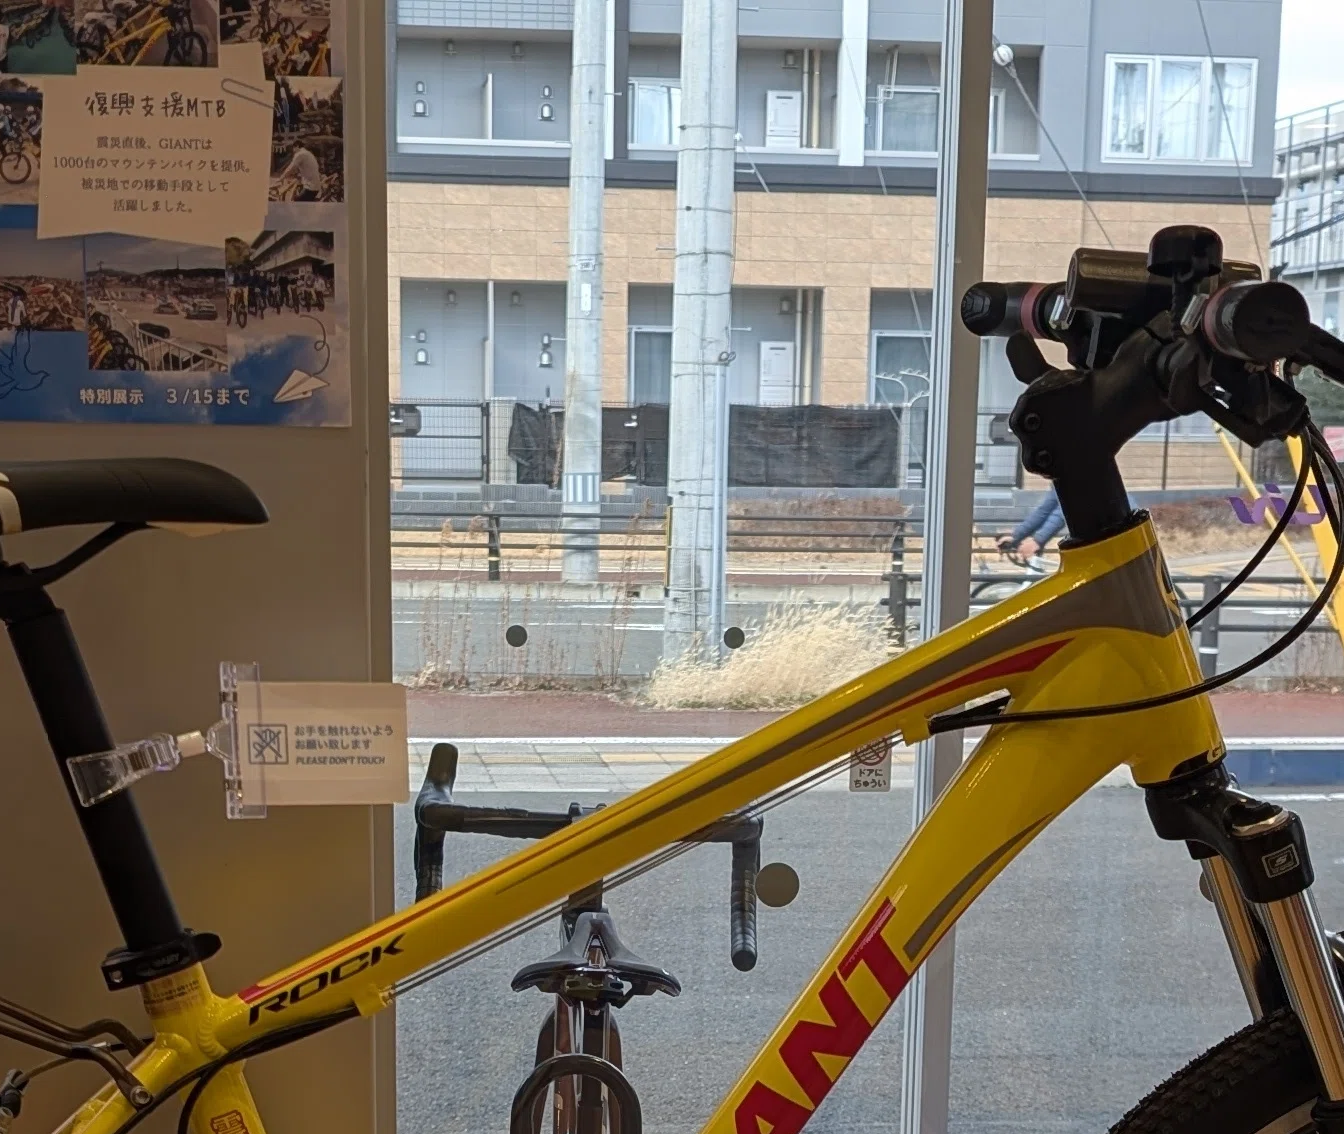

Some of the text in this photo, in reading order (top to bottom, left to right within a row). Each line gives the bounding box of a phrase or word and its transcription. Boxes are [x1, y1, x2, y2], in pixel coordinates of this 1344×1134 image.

[96, 135, 212, 151] 震災直後、GIANTは
[81, 177, 230, 193] 被災地での移動手段として
[112, 199, 194, 214] 活躍しました。
[79, 388, 145, 405] 特別展示
[296, 756, 386, 765] PLEASE DON'T TOUCH
[248, 933, 407, 1026] ROCK
